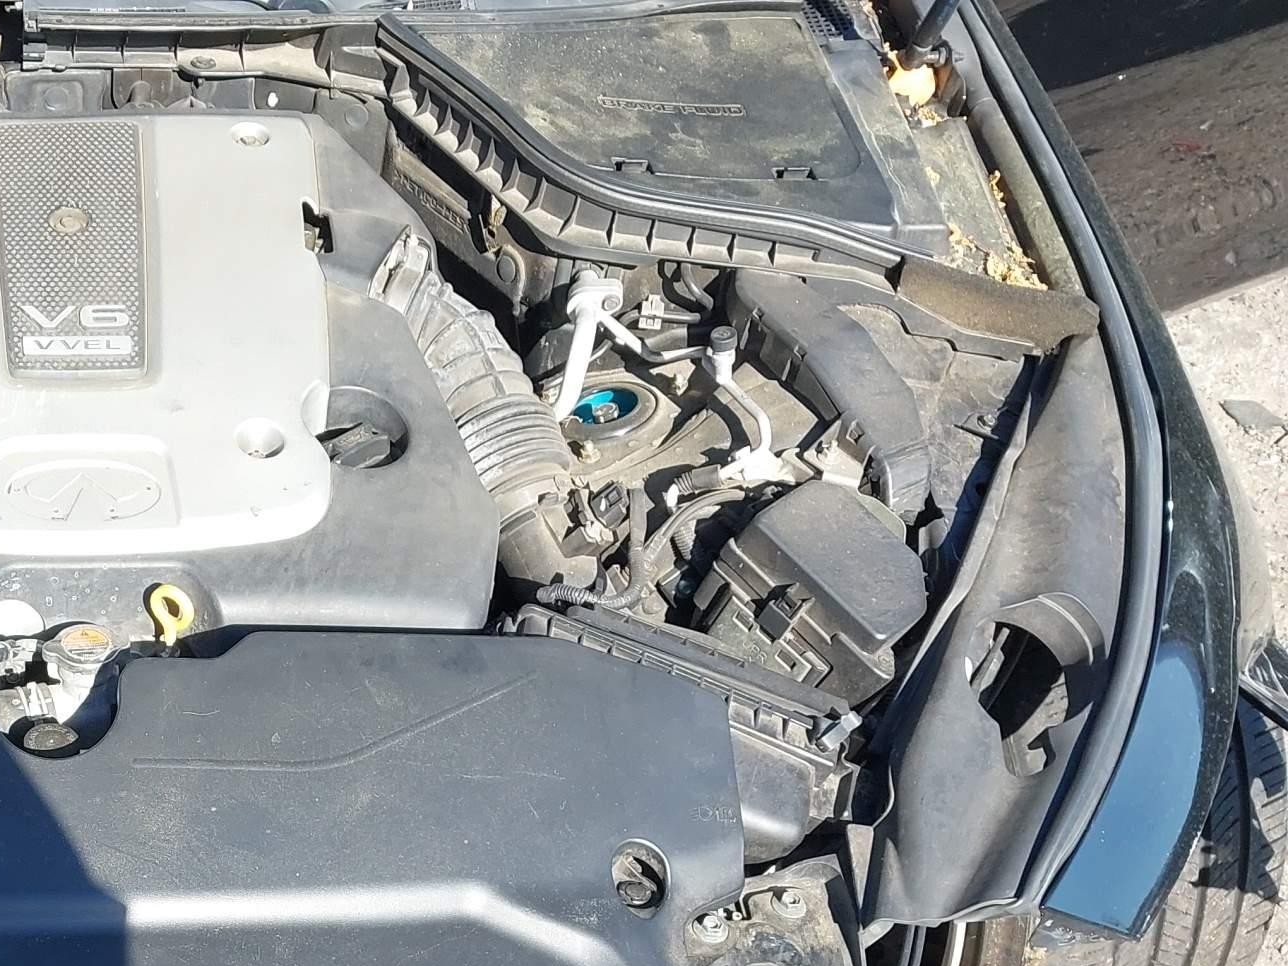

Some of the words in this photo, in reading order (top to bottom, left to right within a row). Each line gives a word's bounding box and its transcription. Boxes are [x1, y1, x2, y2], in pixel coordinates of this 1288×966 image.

[600, 98, 675, 114] BRAKE
[679, 103, 743, 117] FLUID
[20, 304, 130, 329] V6
[32, 339, 121, 350] VVEL
